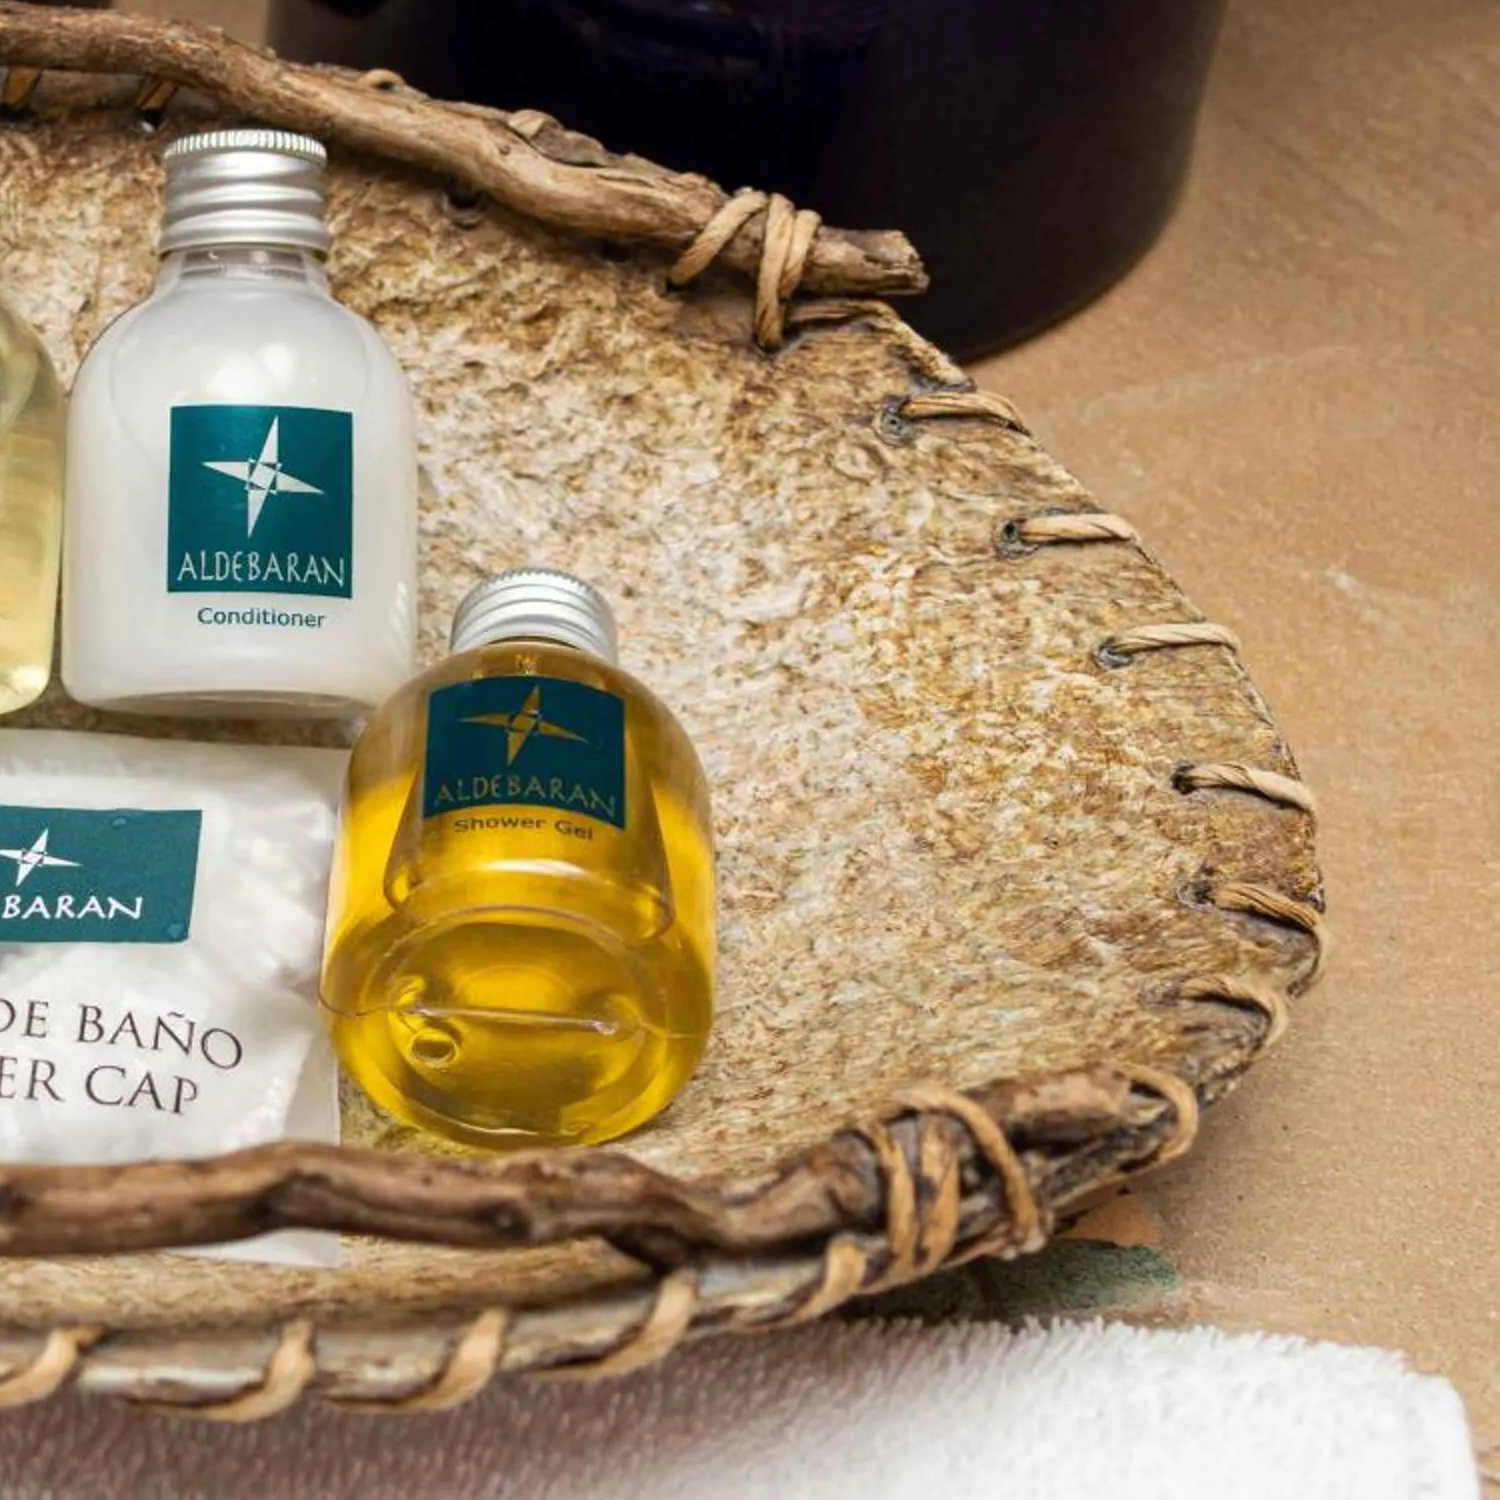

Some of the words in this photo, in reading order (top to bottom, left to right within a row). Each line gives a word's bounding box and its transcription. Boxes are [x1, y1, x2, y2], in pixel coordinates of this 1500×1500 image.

[177, 551, 344, 587] ALDEBARAN
[197, 608, 326, 628] Conditioner
[434, 775, 616, 819] ALDEBARAN
[454, 815, 547, 833] Shower
[555, 821, 593, 840] Gel
[76, 1004, 244, 1071] BAÑO
[84, 1065, 199, 1116] CAP
